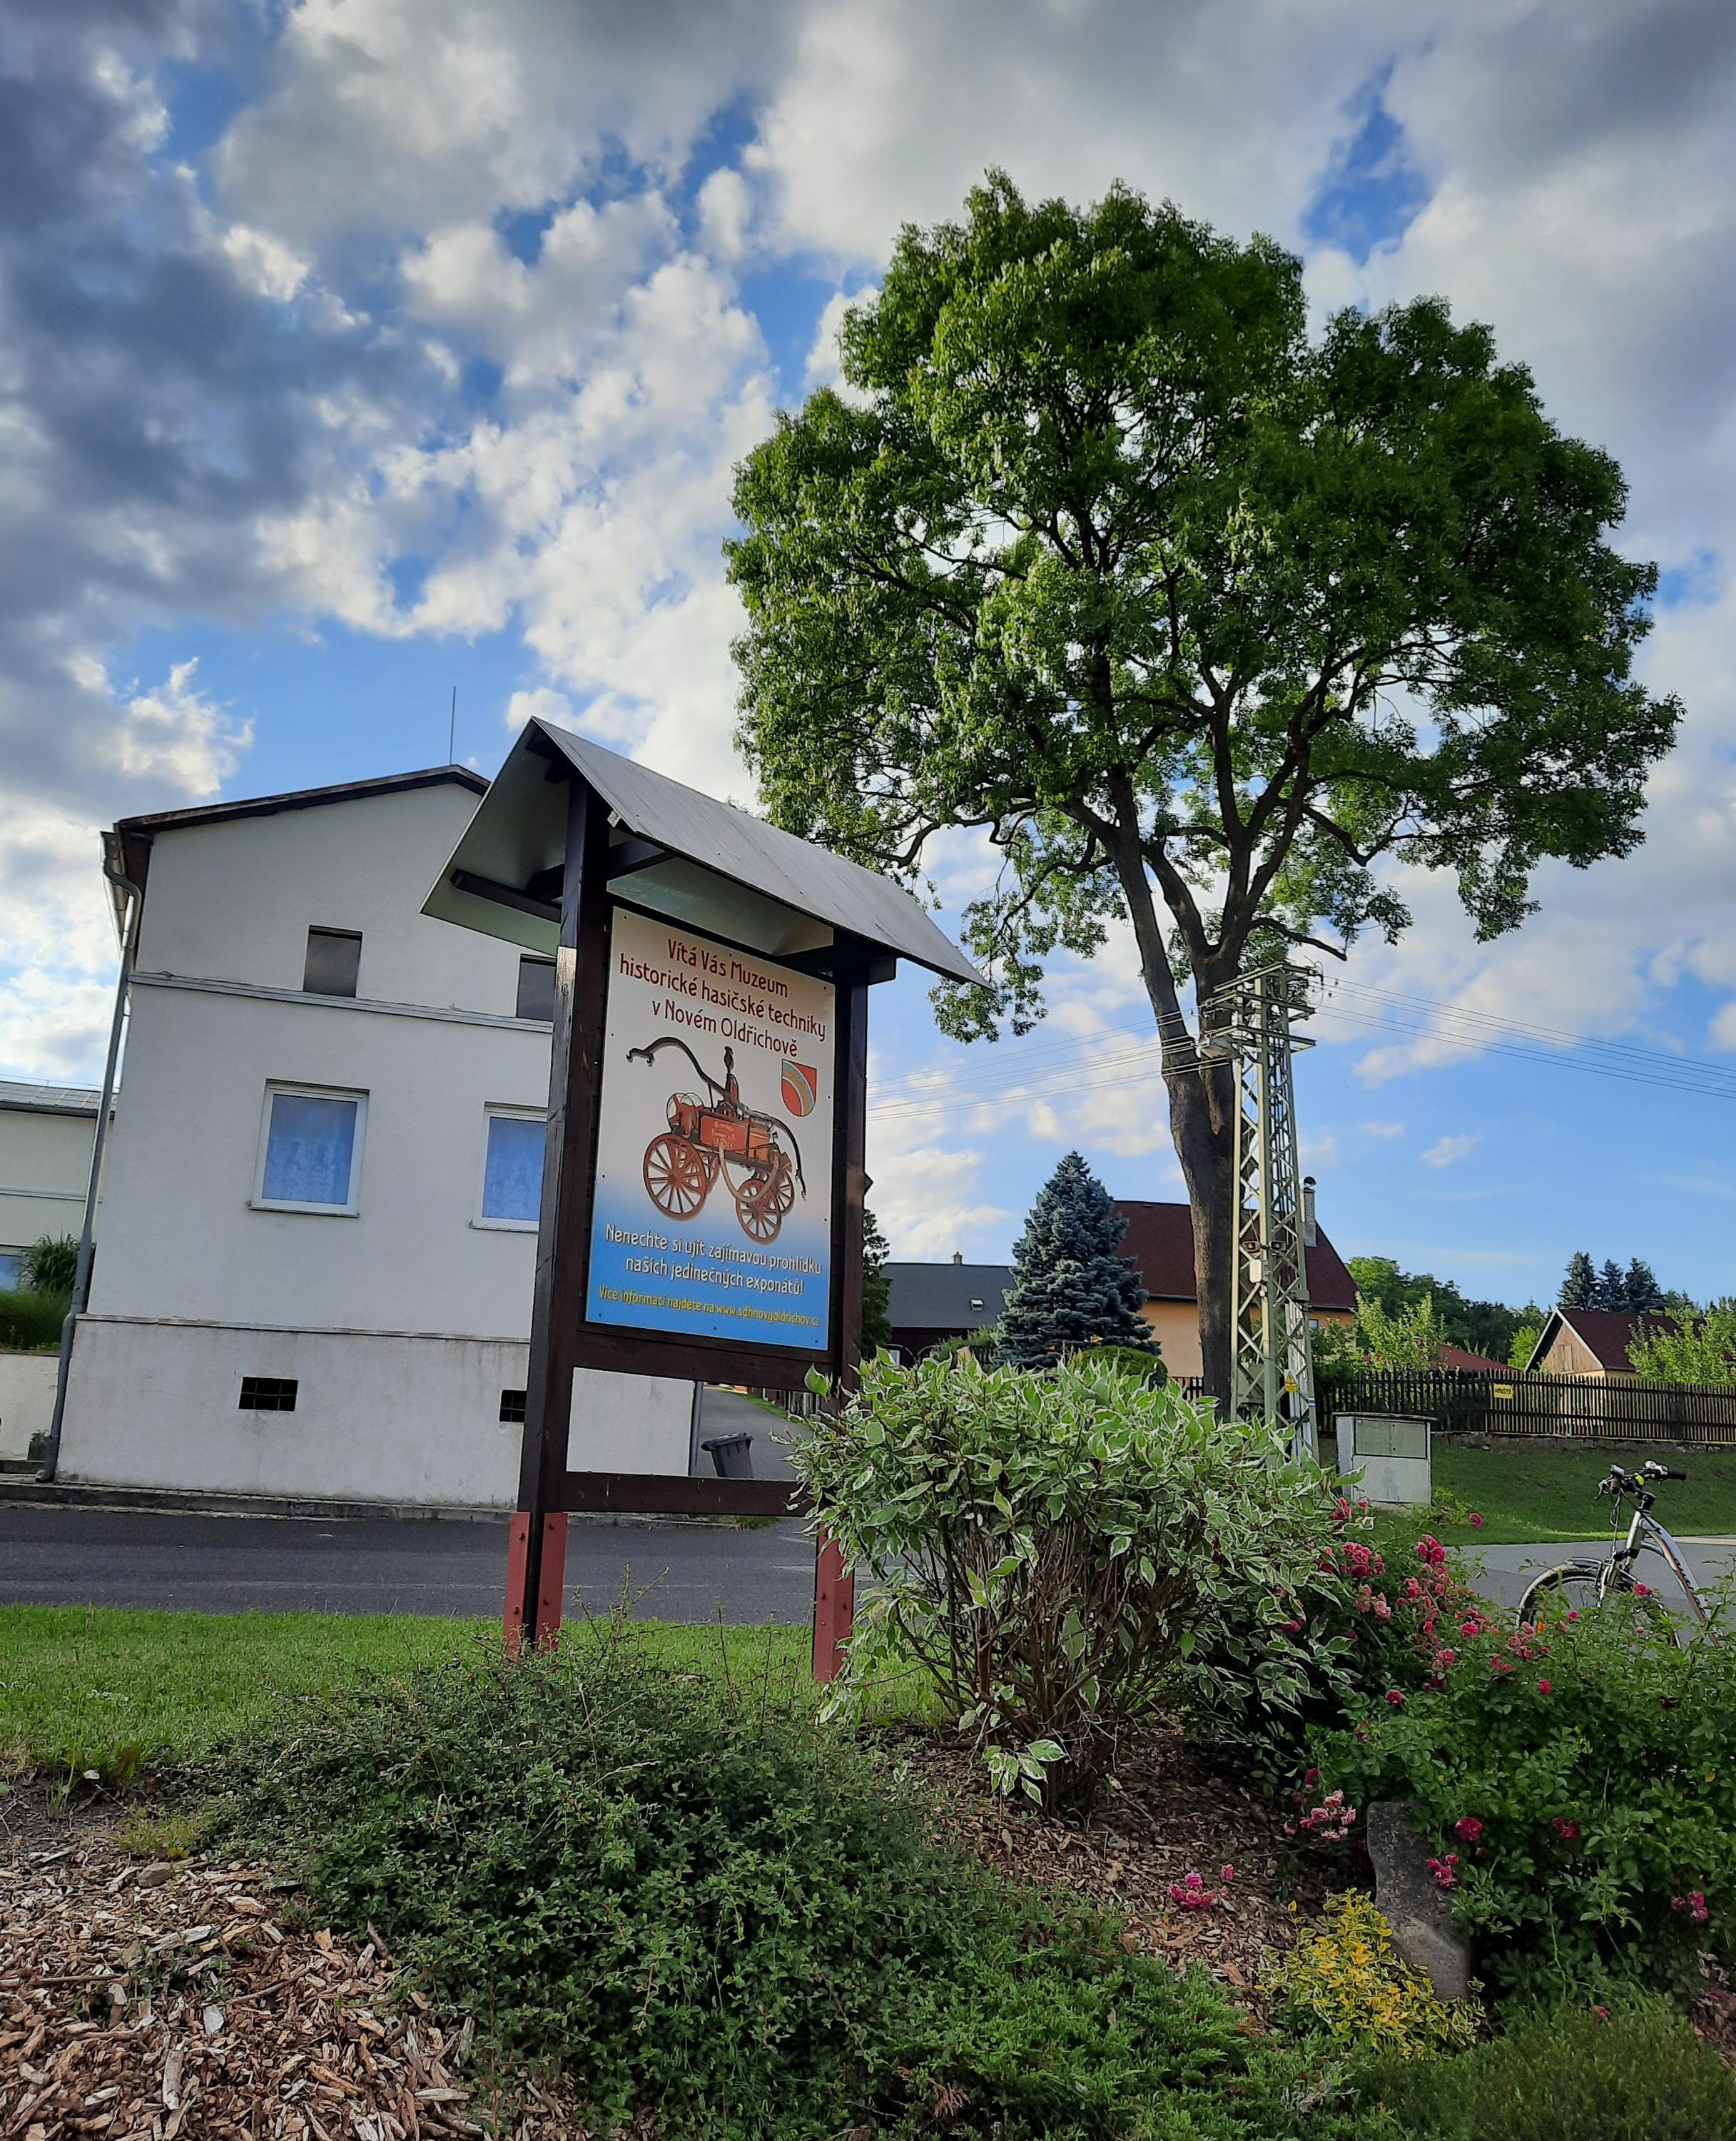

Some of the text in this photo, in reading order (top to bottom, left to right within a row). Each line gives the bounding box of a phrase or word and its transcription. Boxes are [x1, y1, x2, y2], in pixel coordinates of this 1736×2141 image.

[667, 938, 788, 998] Vítá Vás Muzeum
[619, 953, 826, 1042] historické hasičské techniky
[652, 999, 798, 1058] v Novém Oldřichově
[605, 1223, 822, 1275] Nenechte si ujít zajímavou prohlídku
[626, 1256, 804, 1295] našich jedinečných exponátů!
[599, 1286, 619, 1300] Více
[620, 1289, 666, 1305] informací
[667, 1295, 702, 1311] najdete
[704, 1302, 714, 1314] na
